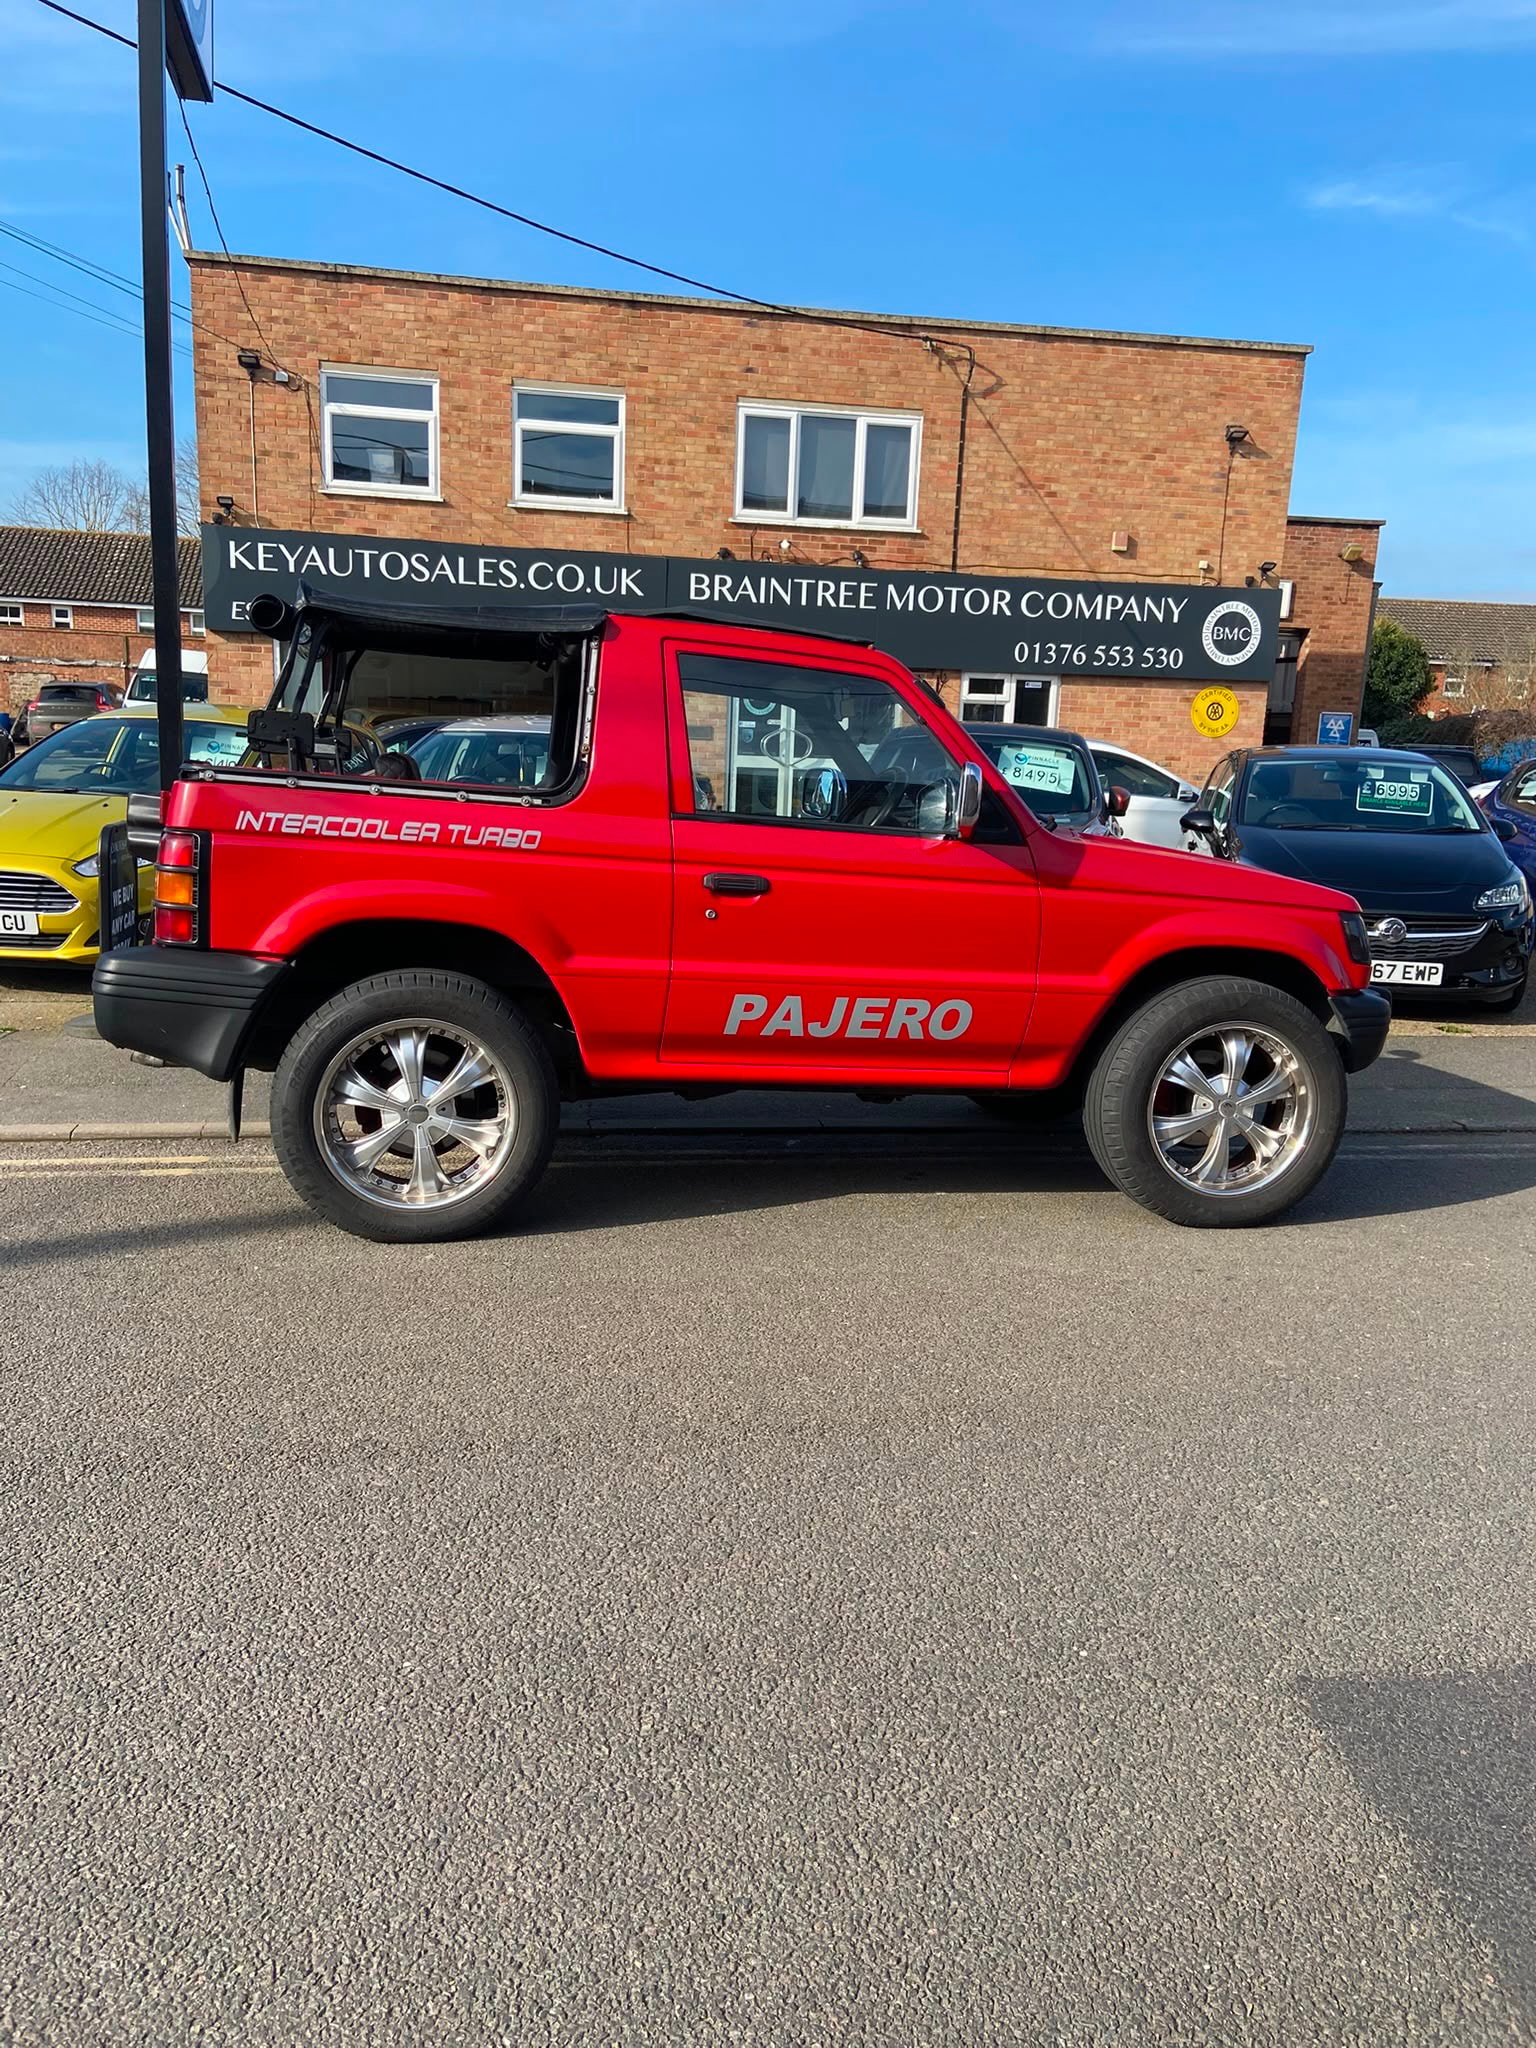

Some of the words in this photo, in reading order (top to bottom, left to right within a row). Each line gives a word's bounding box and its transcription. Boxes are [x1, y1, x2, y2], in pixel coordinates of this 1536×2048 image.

[229, 541, 645, 597] KEYAUTOSALES.CO.UK
[690, 573, 878, 609] BRAINTREE
[886, 584, 1012, 616] MOTOR
[1021, 591, 1189, 623] COMPANY
[1213, 626, 1251, 641] BMC
[1015, 642, 1087, 665] 01376
[1093, 645, 1134, 667] 553
[1141, 647, 1184, 668] 530
[235, 810, 441, 842] INTERCOOLER
[448, 824, 541, 848] TURBO
[1, 914, 26, 932] CU
[1372, 963, 1397, 980] 67
[1402, 965, 1440, 982] EWP
[723, 994, 973, 1041] PAJERO
